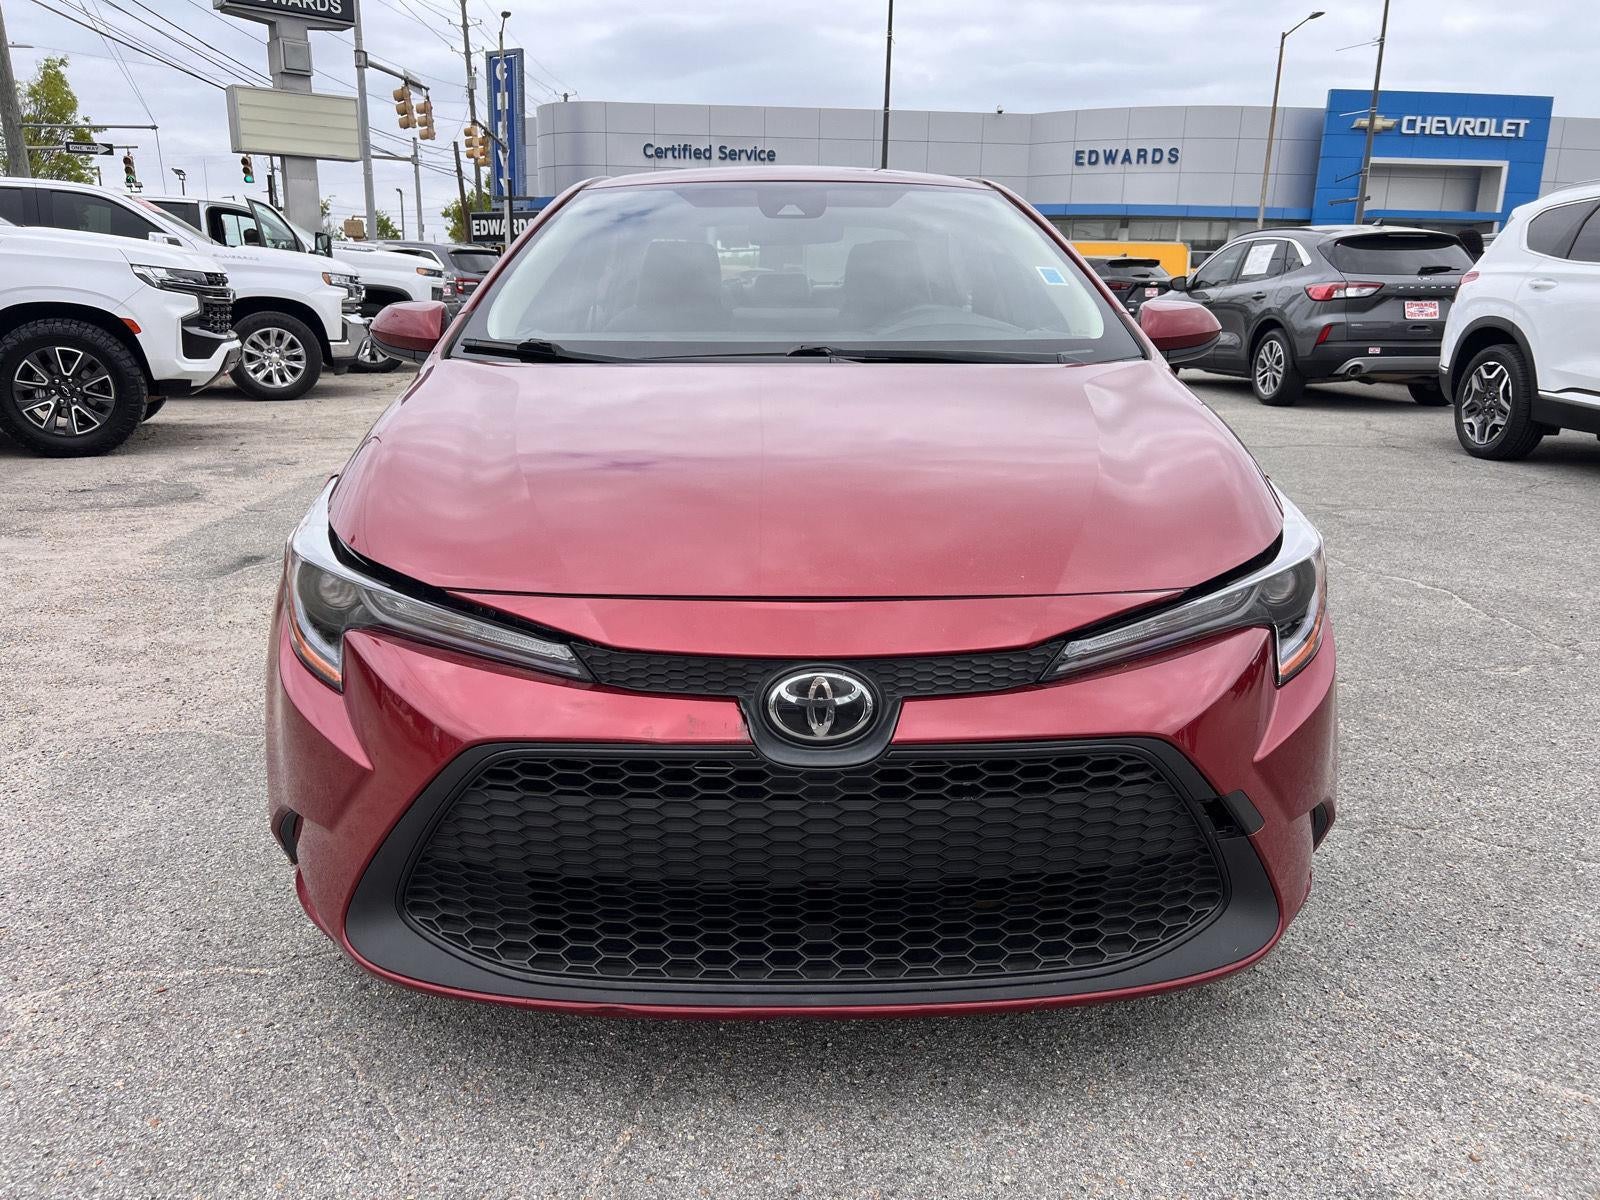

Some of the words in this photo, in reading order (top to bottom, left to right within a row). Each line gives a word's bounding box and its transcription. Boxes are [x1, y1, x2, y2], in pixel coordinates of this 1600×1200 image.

[1401, 115, 1530, 138] CHEVROLET
[643, 143, 712, 160] Certified
[718, 145, 776, 162] Service
[1074, 147, 1180, 166] EDWARDS
